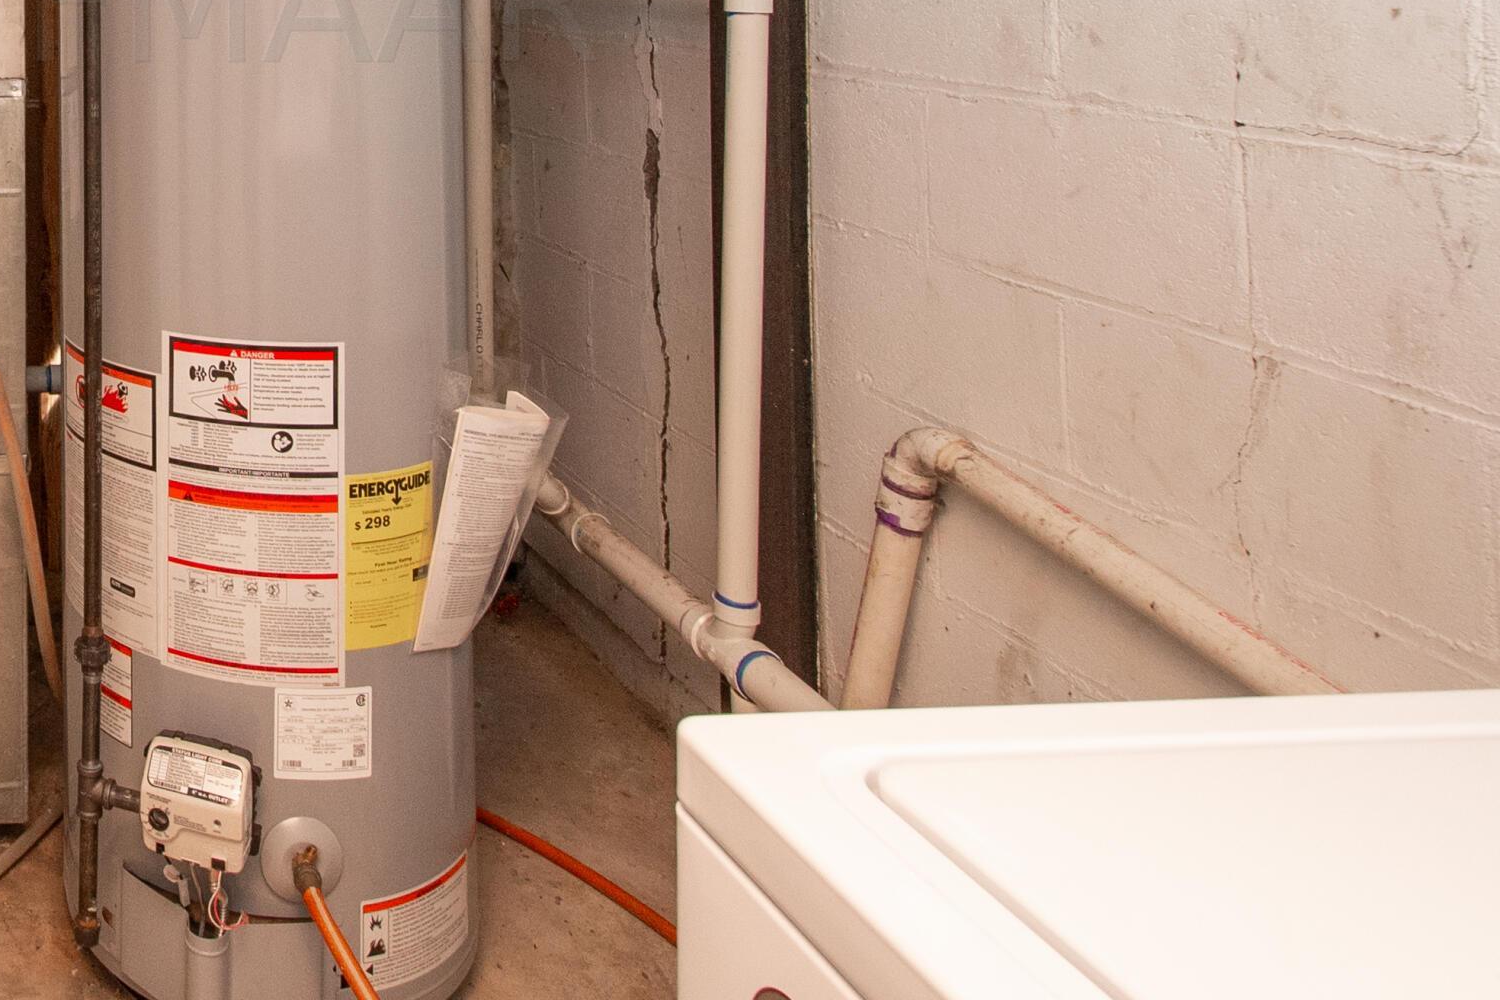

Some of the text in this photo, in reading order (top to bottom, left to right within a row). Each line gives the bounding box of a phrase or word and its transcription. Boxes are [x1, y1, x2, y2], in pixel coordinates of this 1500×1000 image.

[240, 350, 275, 360] DANGER
[349, 470, 431, 503] ENERGYGUIDE
[354, 515, 391, 531] $ 298
